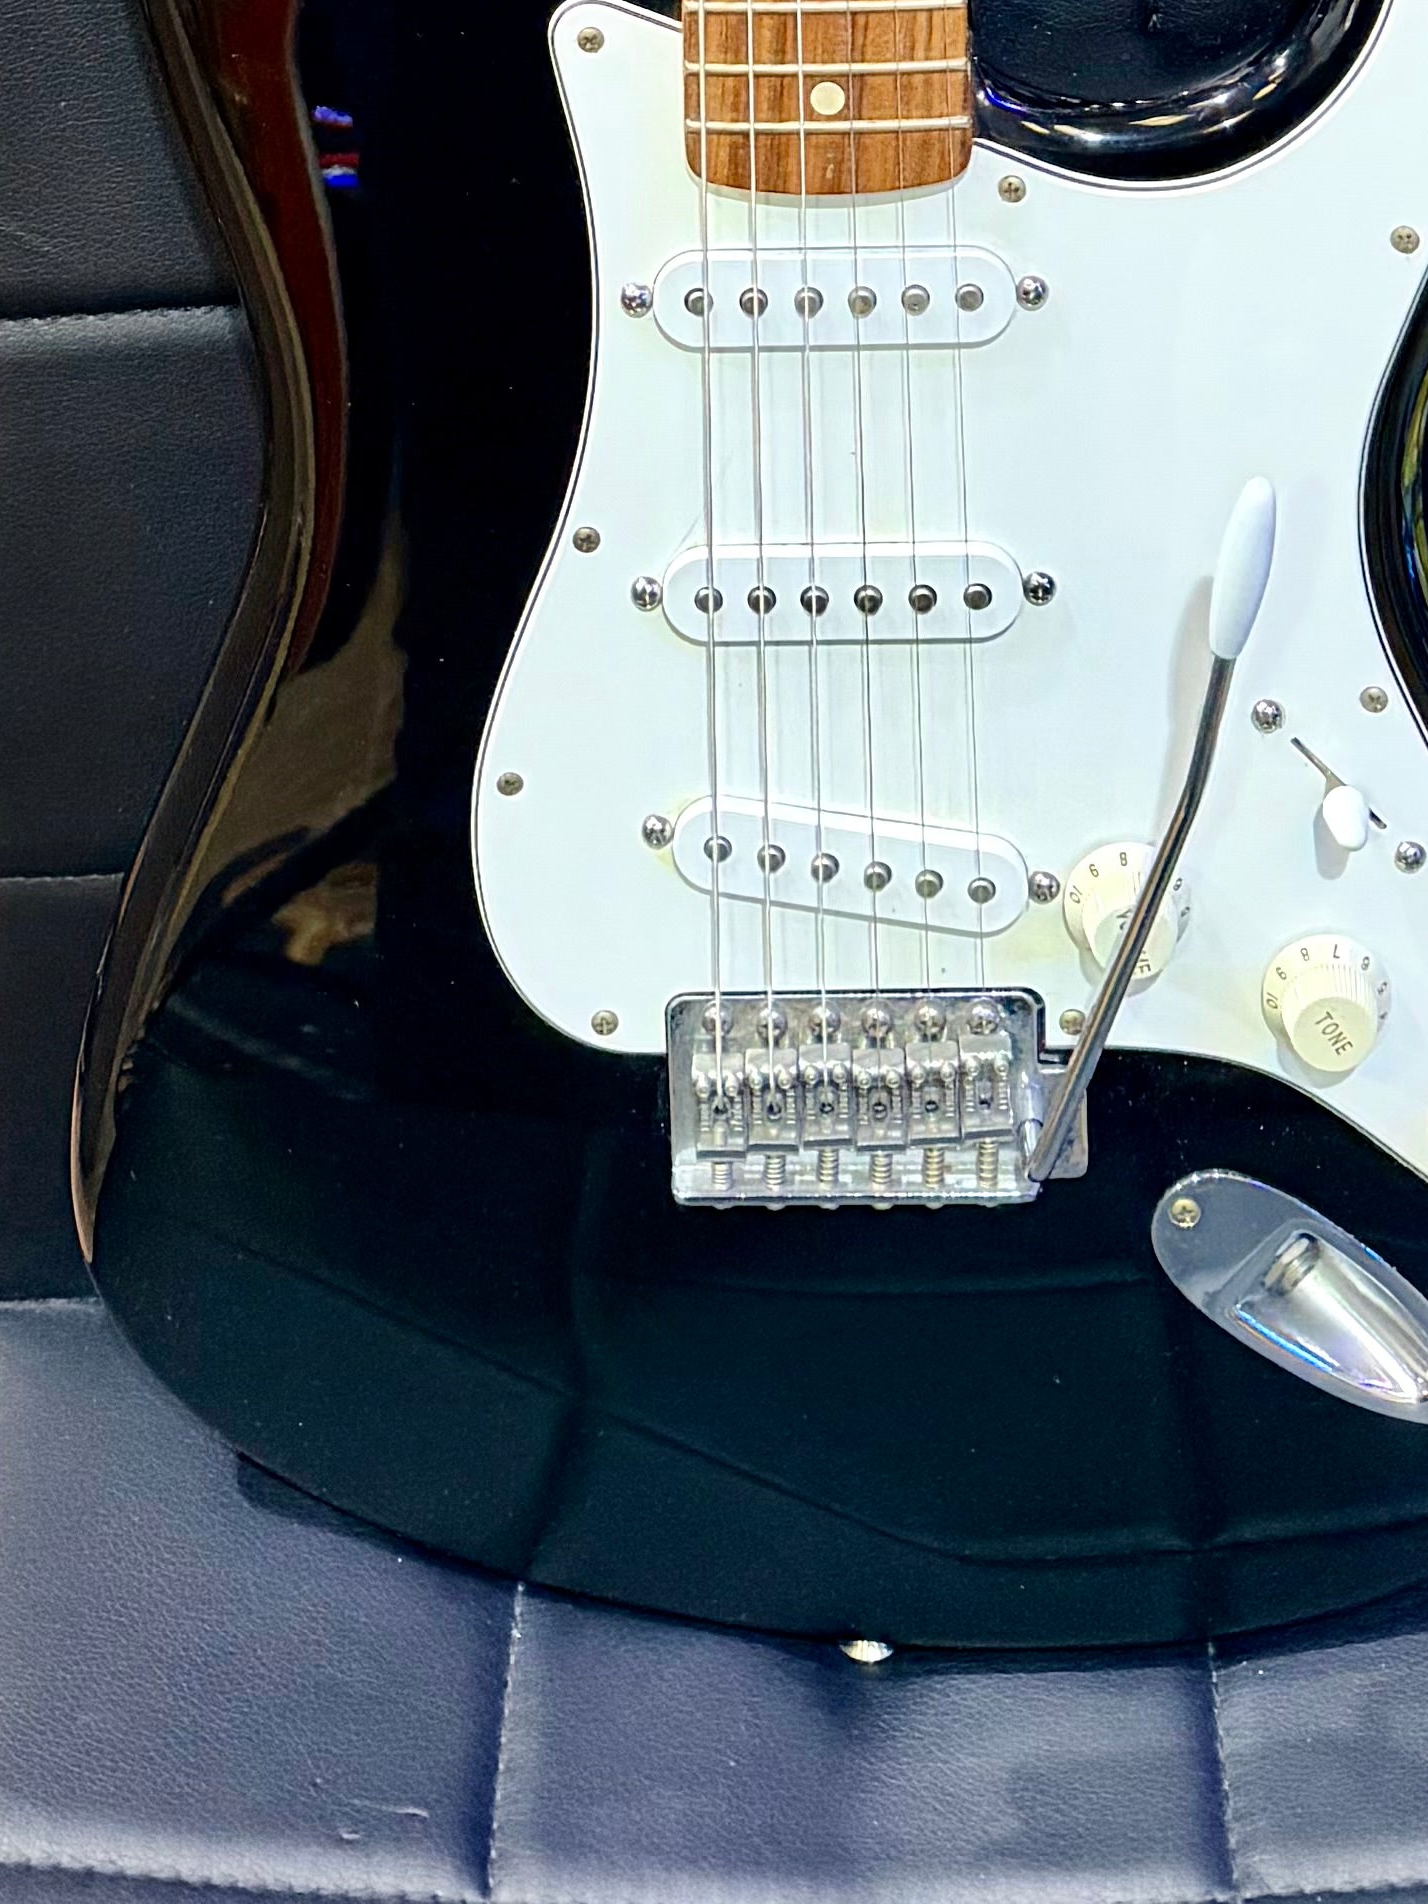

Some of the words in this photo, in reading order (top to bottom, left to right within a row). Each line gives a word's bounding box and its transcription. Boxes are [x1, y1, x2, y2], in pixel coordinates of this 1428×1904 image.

[1120, 852, 1127, 866] 8
[1300, 948, 1309, 961] 8
[1315, 1011, 1354, 1056] TONE
